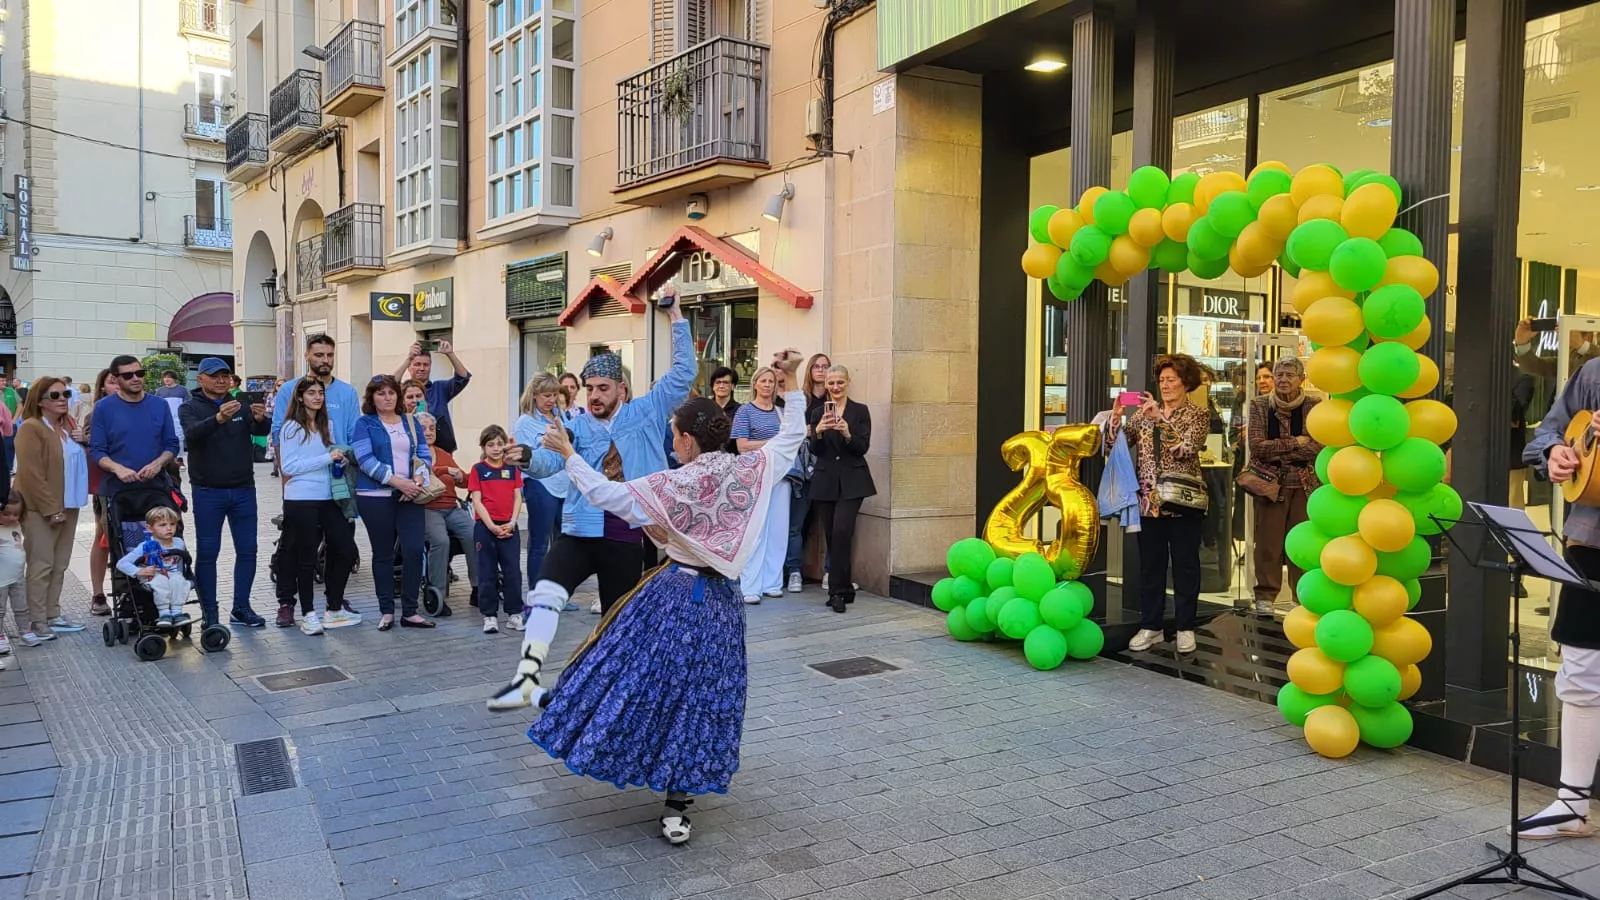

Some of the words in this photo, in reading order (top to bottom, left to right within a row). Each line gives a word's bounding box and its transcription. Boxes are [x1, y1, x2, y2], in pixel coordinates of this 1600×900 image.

[18, 176, 29, 255] HOSTAL
[416, 286, 447, 312] embou
[1203, 294, 1239, 316] DIOR
